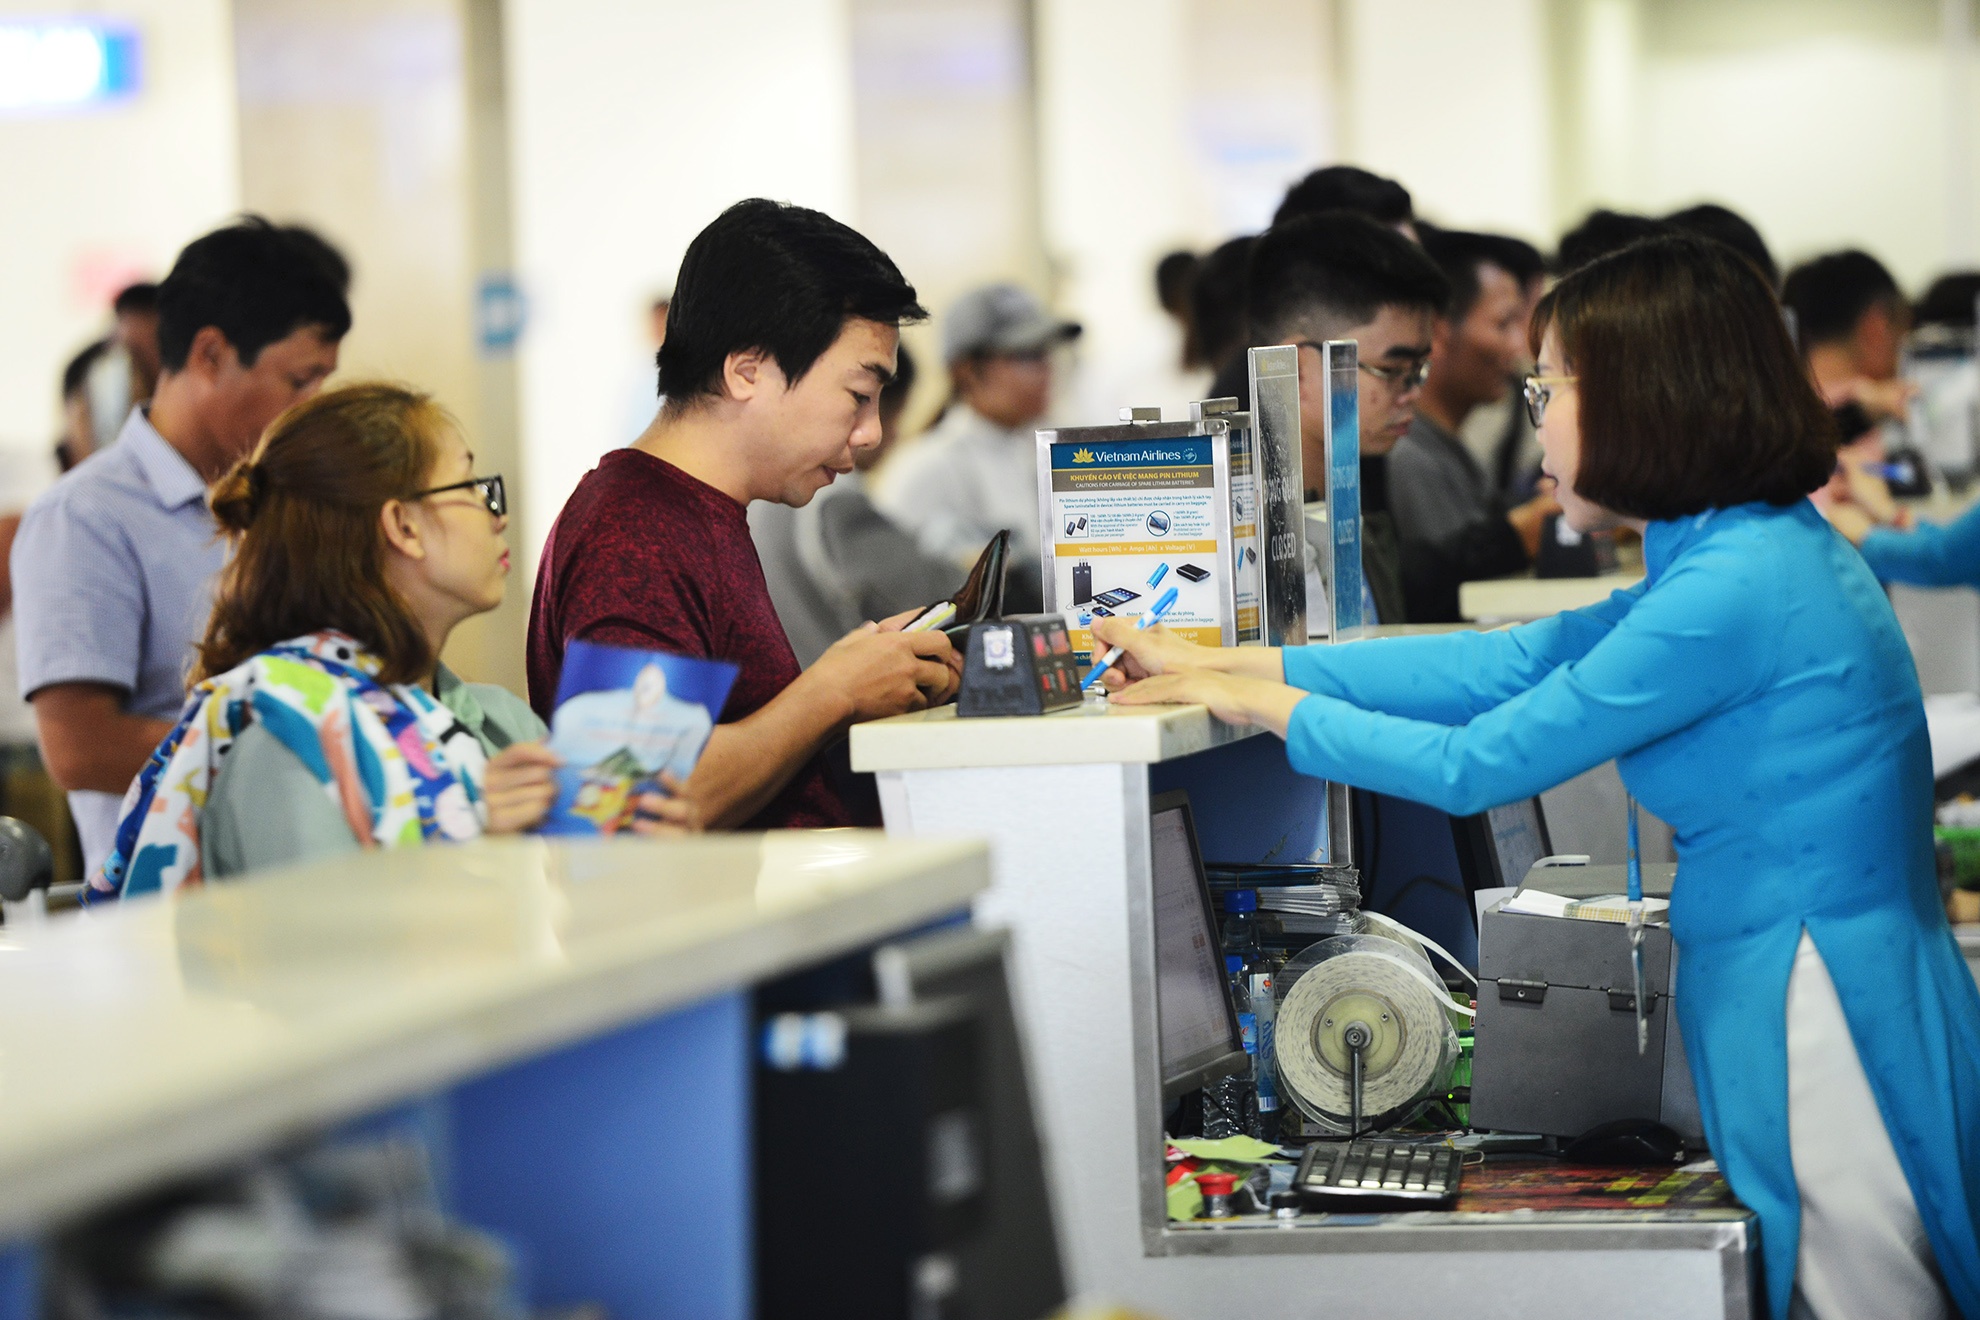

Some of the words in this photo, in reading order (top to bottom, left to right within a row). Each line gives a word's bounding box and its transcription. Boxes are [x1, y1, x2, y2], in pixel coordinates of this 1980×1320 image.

[1095, 451, 1140, 462] Vietnam
[1141, 450, 1181, 461] Airlines
[1272, 532, 1296, 561] CLOSED
